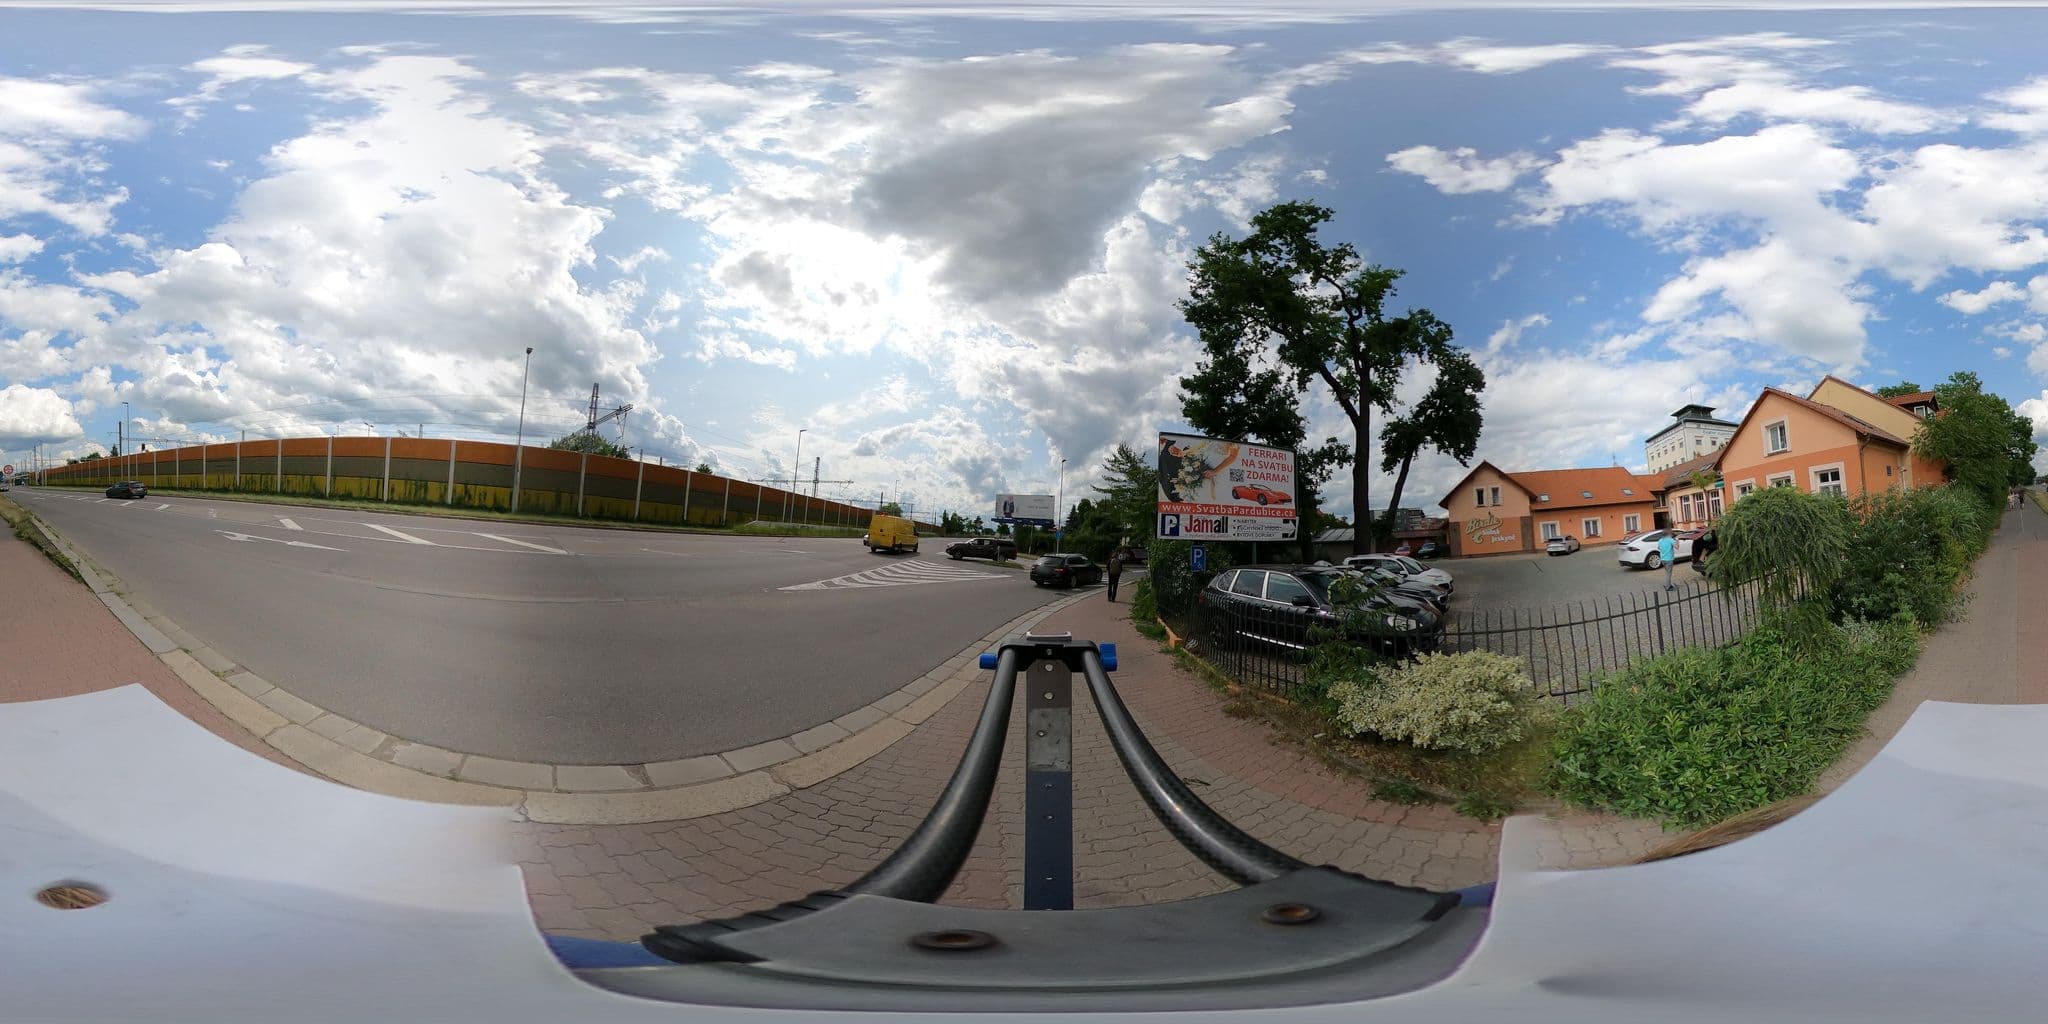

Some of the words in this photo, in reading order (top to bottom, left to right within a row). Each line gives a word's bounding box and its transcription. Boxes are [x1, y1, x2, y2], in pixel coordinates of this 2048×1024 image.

[1248, 448, 1287, 461] FERRARI
[1242, 458, 1256, 468] NA
[1258, 461, 1293, 472] SVATBU
[1246, 470, 1289, 483] ZDARMA!
[1162, 504, 1294, 517] www.SvatbaPardubice.cz
[1165, 515, 1178, 535] P
[1185, 515, 1228, 533] Jamall
[1194, 549, 1204, 563] P
